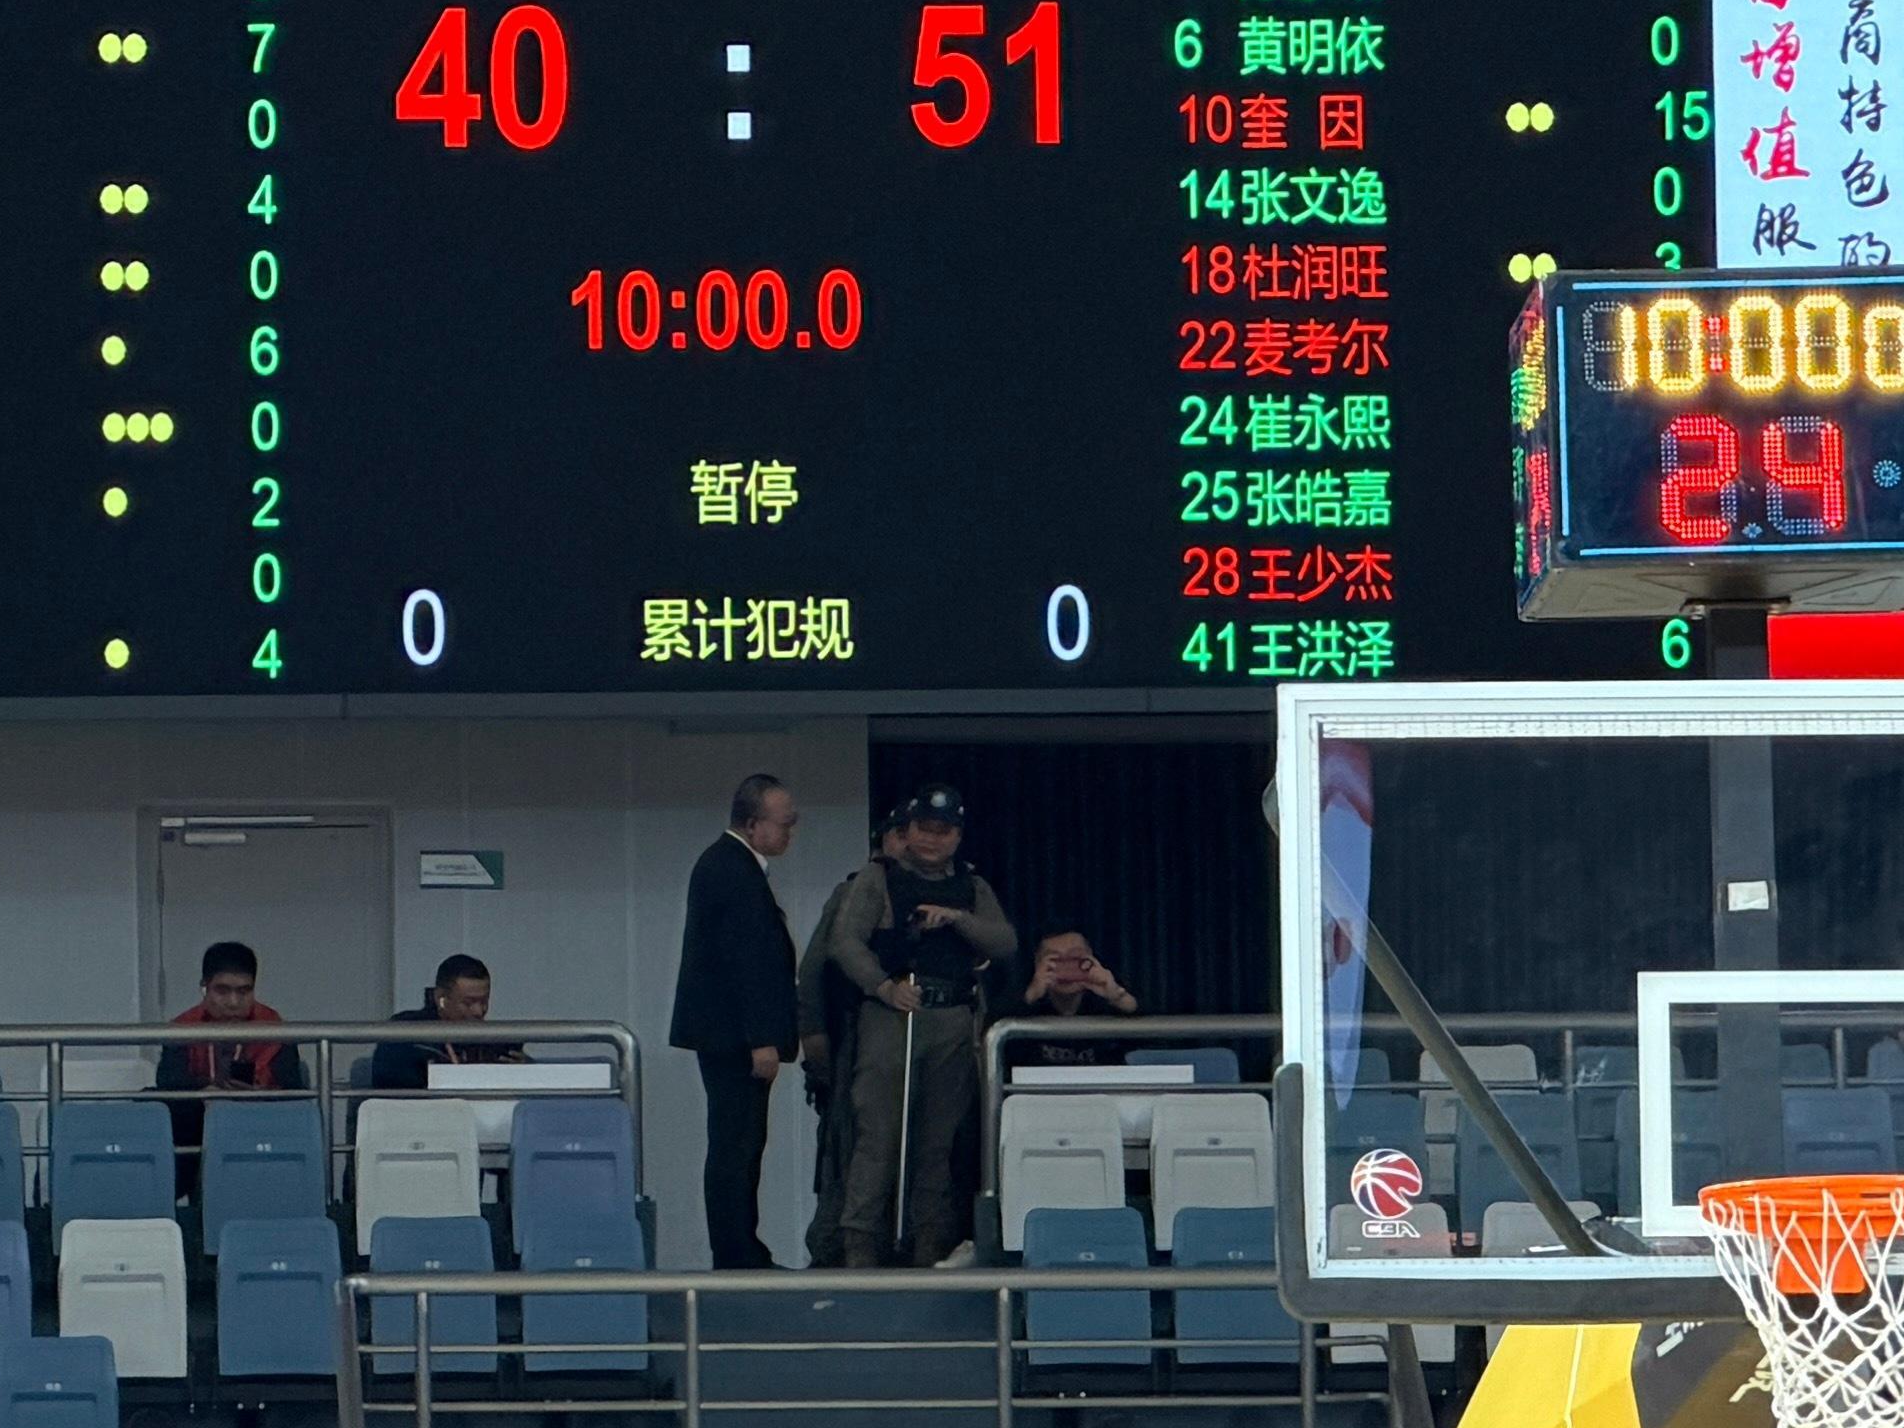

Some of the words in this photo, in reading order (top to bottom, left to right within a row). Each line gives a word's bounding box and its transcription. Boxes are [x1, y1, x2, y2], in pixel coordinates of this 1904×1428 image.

[248, 23, 275, 73] 7
[1175, 19, 1202, 68] 6
[1239, 16, 1384, 75] 黄明依
[1651, 16, 1679, 65] 0
[396, 5, 568, 149] 40
[911, 2, 1060, 147] 51
[249, 99, 276, 149] 0
[1180, 95, 1232, 143] 10
[1656, 91, 1708, 140] 15
[248, 175, 277, 224] 4
[1180, 169, 1235, 219] 14
[1242, 167, 1387, 224] 张文逸
[1654, 167, 1682, 215] 0
[250, 250, 278, 300] 0
[1182, 245, 1235, 294] 18
[1243, 244, 1388, 300] 杜润旺
[572, 269, 861, 351] 10:00.0
[251, 326, 279, 375] 6
[1180, 321, 1236, 369] 22
[1244, 318, 1388, 376] 麦考尔
[252, 402, 279, 451] 0
[1180, 395, 1238, 445] 24
[1245, 393, 1390, 452] 崔永熙
[252, 477, 280, 527] 2
[691, 460, 798, 524] 暂停
[1181, 471, 1240, 521] 25
[1246, 469, 1392, 527] 张皓嘉
[1660, 413, 1845, 541] 24
[253, 553, 280, 602] 0
[1184, 547, 1239, 595] 28
[1249, 545, 1392, 601] 王少杰
[403, 589, 445, 665] 0
[641, 597, 853, 661] 累计犯规
[1047, 585, 1089, 660] 0
[1182, 622, 1234, 671] 41
[1249, 620, 1394, 677] 王洪泽
[1662, 619, 1690, 668] 6
[252, 629, 282, 678] 4
[1362, 1220, 1421, 1238] CBA
